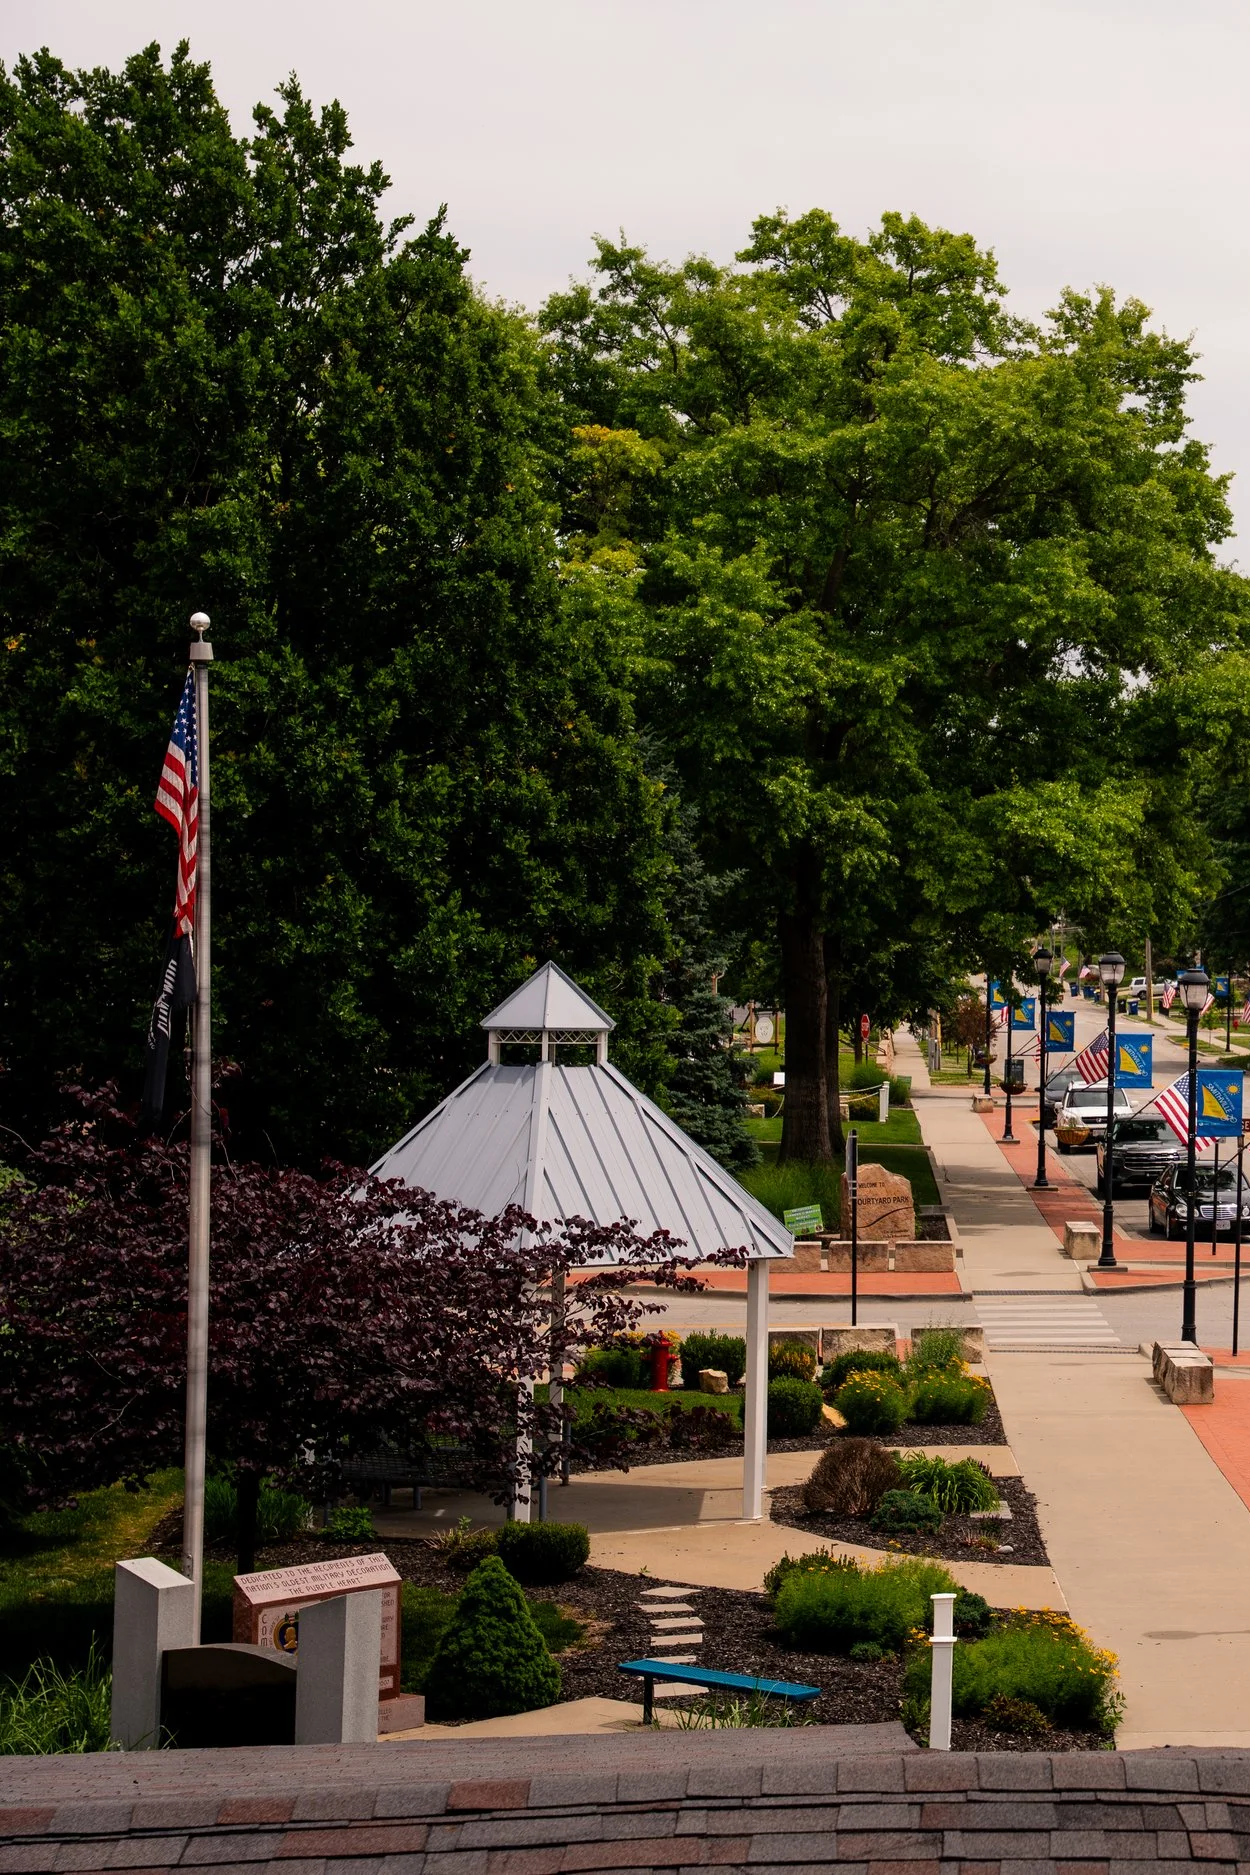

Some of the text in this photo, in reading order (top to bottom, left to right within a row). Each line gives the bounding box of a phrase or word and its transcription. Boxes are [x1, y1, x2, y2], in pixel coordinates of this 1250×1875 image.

[857, 1196, 910, 1205] OURTYARD PARK
[240, 1556, 385, 1585] DEDICATED TO THE RECIPIENTS OF THIS
[282, 1577, 309, 1588] OLDEST
[311, 1570, 345, 1583] MILITARY
[346, 1563, 392, 1577] DECORATION
[306, 1582, 335, 1592] PURPLE
